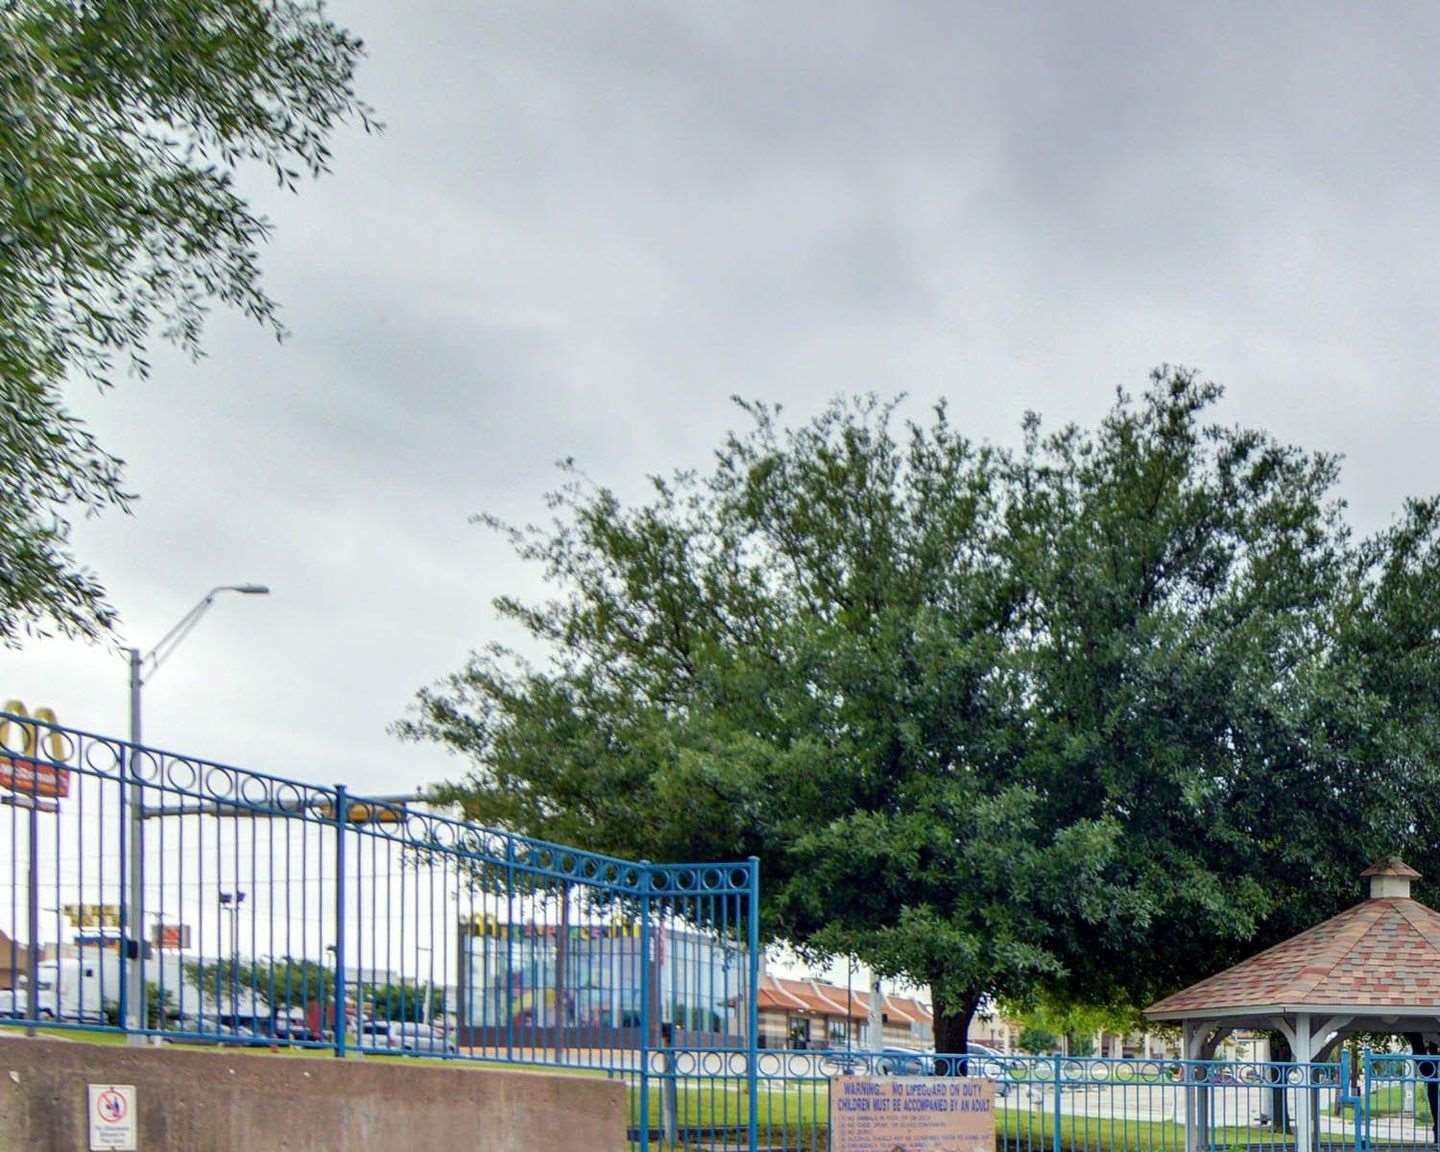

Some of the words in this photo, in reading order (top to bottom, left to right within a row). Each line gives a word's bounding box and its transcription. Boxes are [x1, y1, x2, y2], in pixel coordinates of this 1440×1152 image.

[892, 1083, 903, 1096] NO
[906, 1084, 947, 1097] LIFEGUARD
[950, 1084, 960, 1097] ON
[963, 1084, 982, 1098] DUTY
[837, 1099, 870, 1112] CHILDREN
[873, 1099, 890, 1111] MUST
[893, 1099, 901, 1111] BE
[904, 1099, 947, 1112] ACCOMPANIED
[949, 1099, 959, 1112] BY
[961, 1100, 969, 1112] AN
[972, 1100, 990, 1112] ADULT
